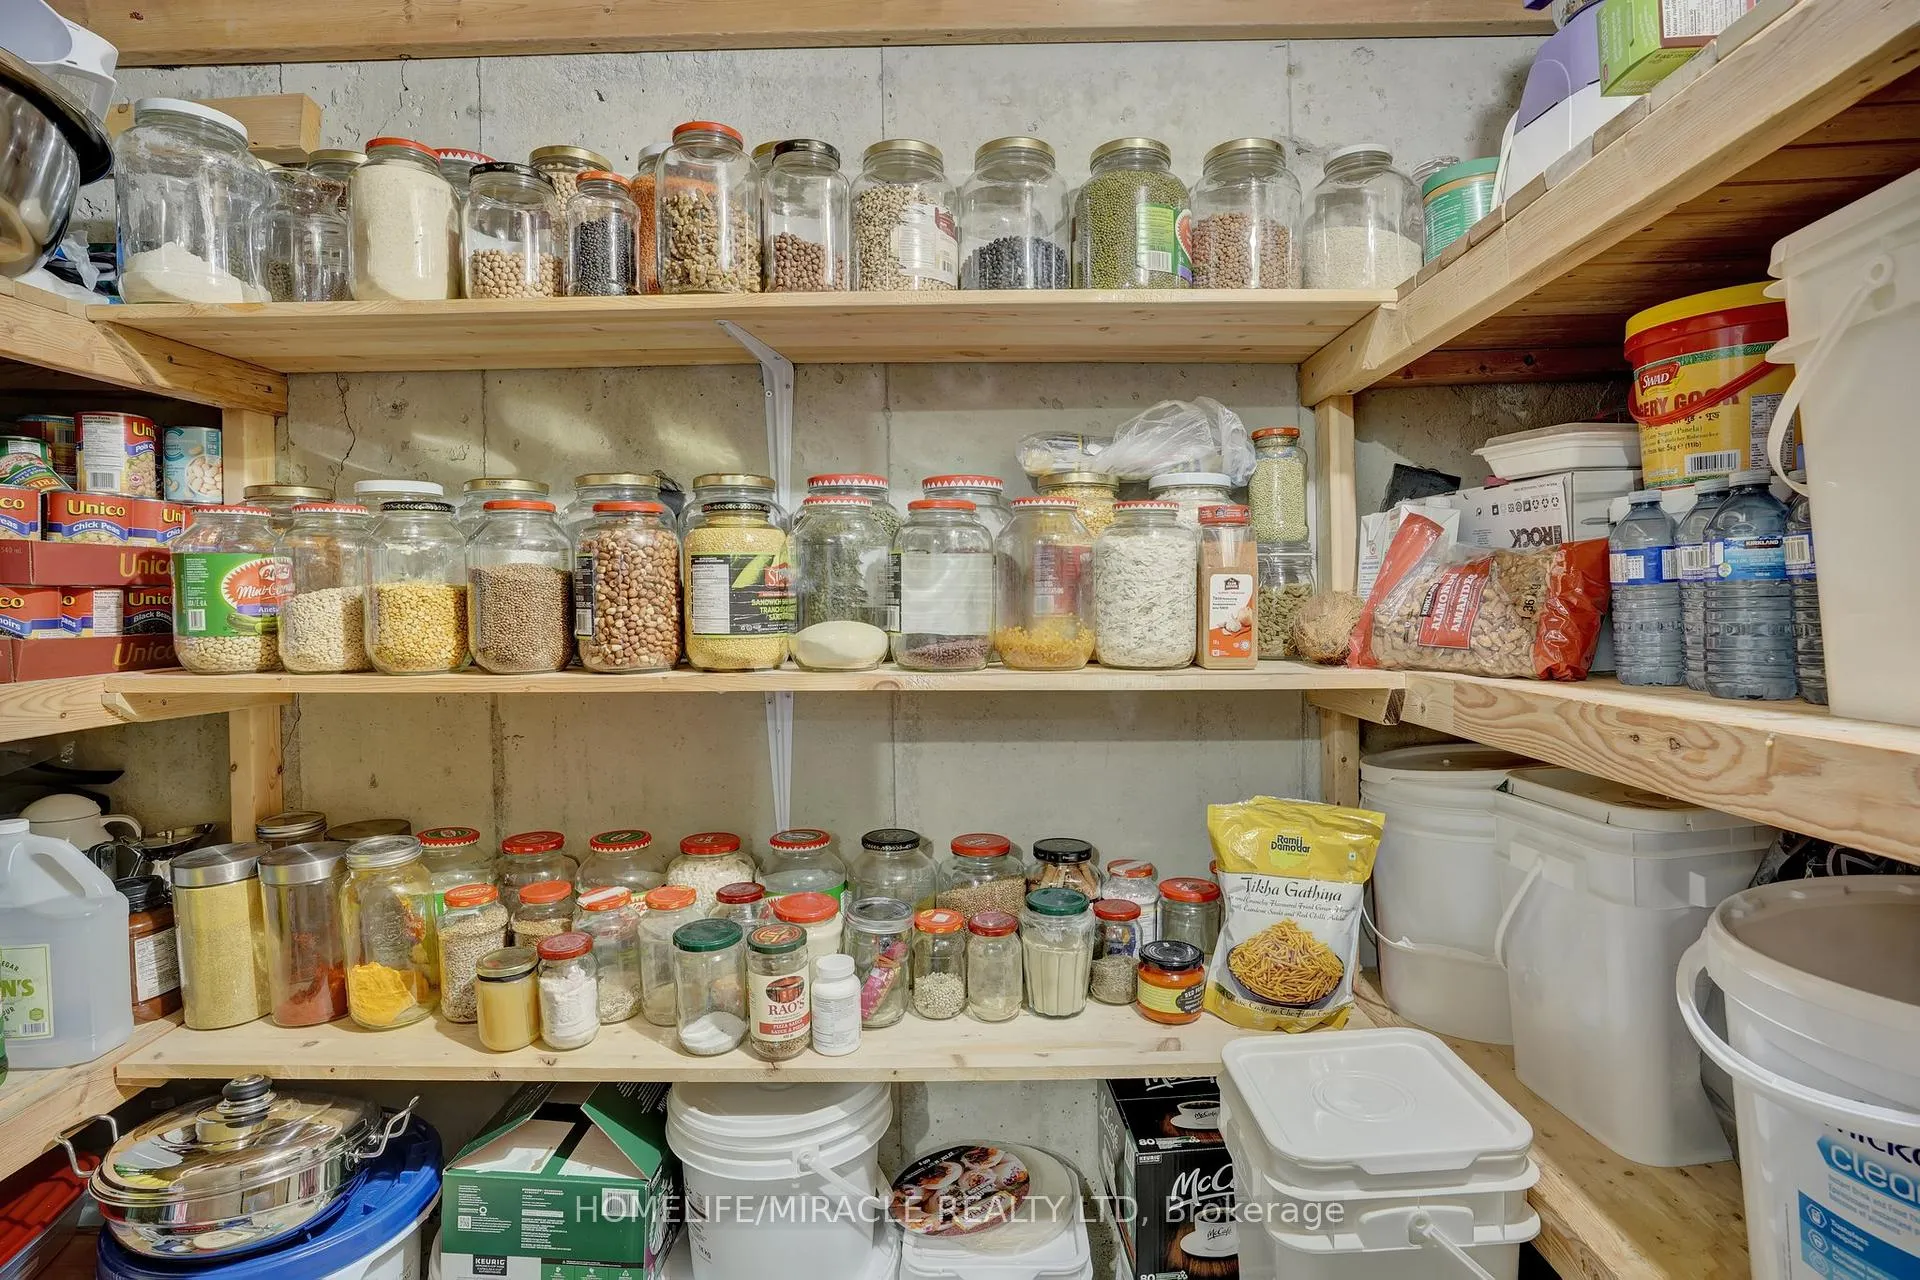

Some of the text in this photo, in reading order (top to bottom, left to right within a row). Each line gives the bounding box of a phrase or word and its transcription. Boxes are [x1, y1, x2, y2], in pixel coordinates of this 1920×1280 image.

[1643, 373, 1669, 389] SWAD
[67, 499, 127, 516] Unico
[162, 508, 183, 523] Un
[0, 519, 18, 530] eas
[73, 521, 121, 535] Chick Peas
[1509, 525, 1554, 548] ROCK
[1745, 539, 1779, 547] KIRKLAND
[133, 611, 155, 623] Black
[1271, 841, 1311, 853] Damodar
[1241, 876, 1342, 902] Tikha Gathiya
[0, 978, 35, 998] N'S
[768, 1000, 805, 1015] RAO'S
[1138, 1138, 1156, 1146] 80
[1169, 1163, 1234, 1207] McC
[475, 1258, 506, 1266] KEURIG
